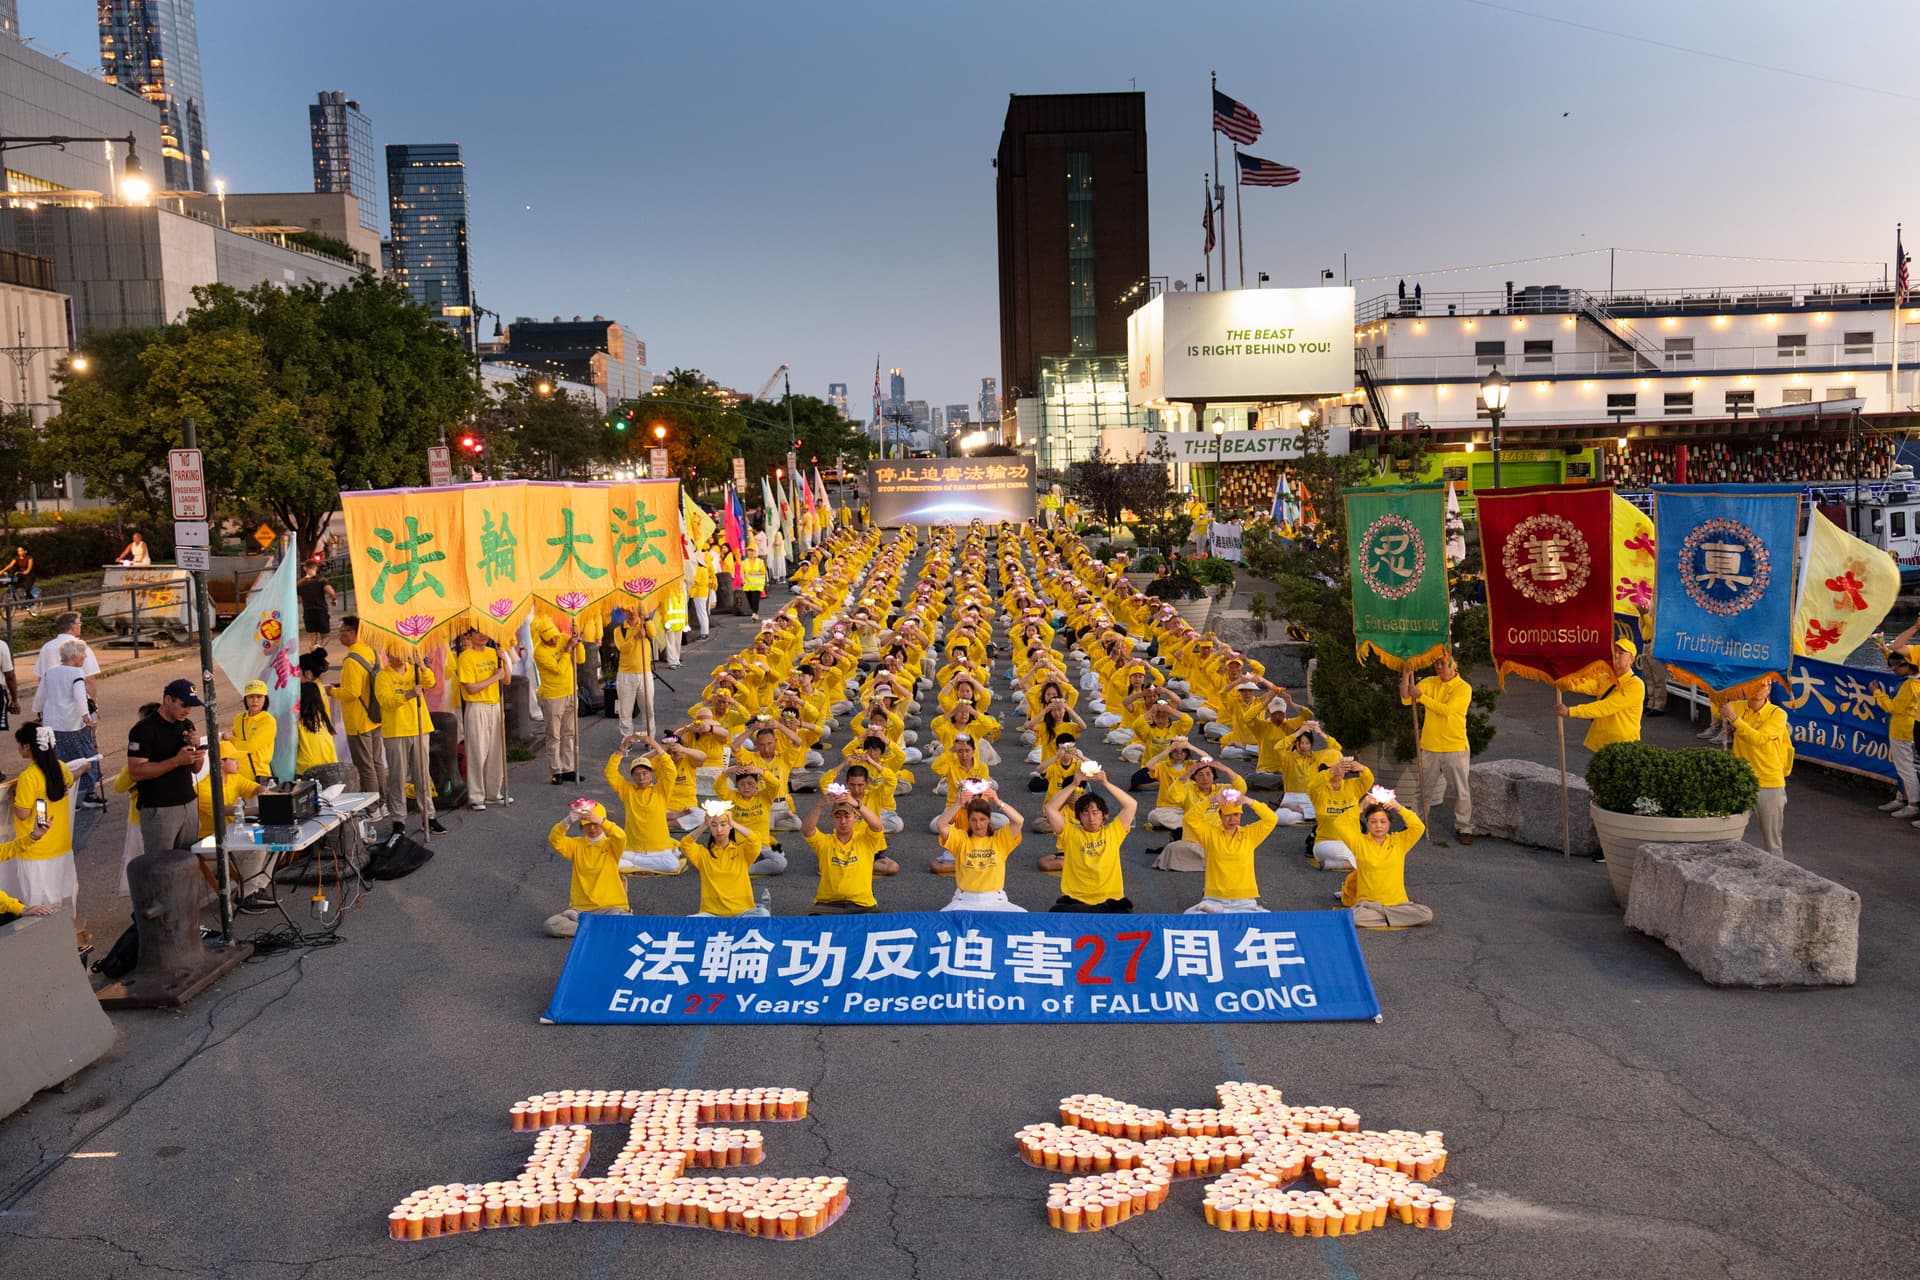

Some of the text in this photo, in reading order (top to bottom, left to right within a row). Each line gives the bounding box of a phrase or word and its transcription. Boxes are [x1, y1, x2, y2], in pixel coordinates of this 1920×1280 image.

[1226, 328, 1294, 341] THE BEAST
[1187, 342, 1331, 357] IS RIGHT BEHIND YOU!
[1184, 438, 1221, 454] THE
[181, 455, 190, 466] NO
[174, 470, 200, 481] PARKING
[875, 463, 1029, 483] 停止迫害法輪功
[366, 500, 667, 605] 法輪大法
[1370, 534, 1413, 578] 忍
[1517, 533, 1579, 582] 善
[1507, 625, 1600, 646] Compassion
[1675, 631, 1771, 661] Truthfulness
[1832, 724, 1846, 750] Is
[624, 927, 1305, 987] 法輪功反迫害27周年
[608, 984, 1318, 1015] End 27 Years' Persecution of FALUN GONG
